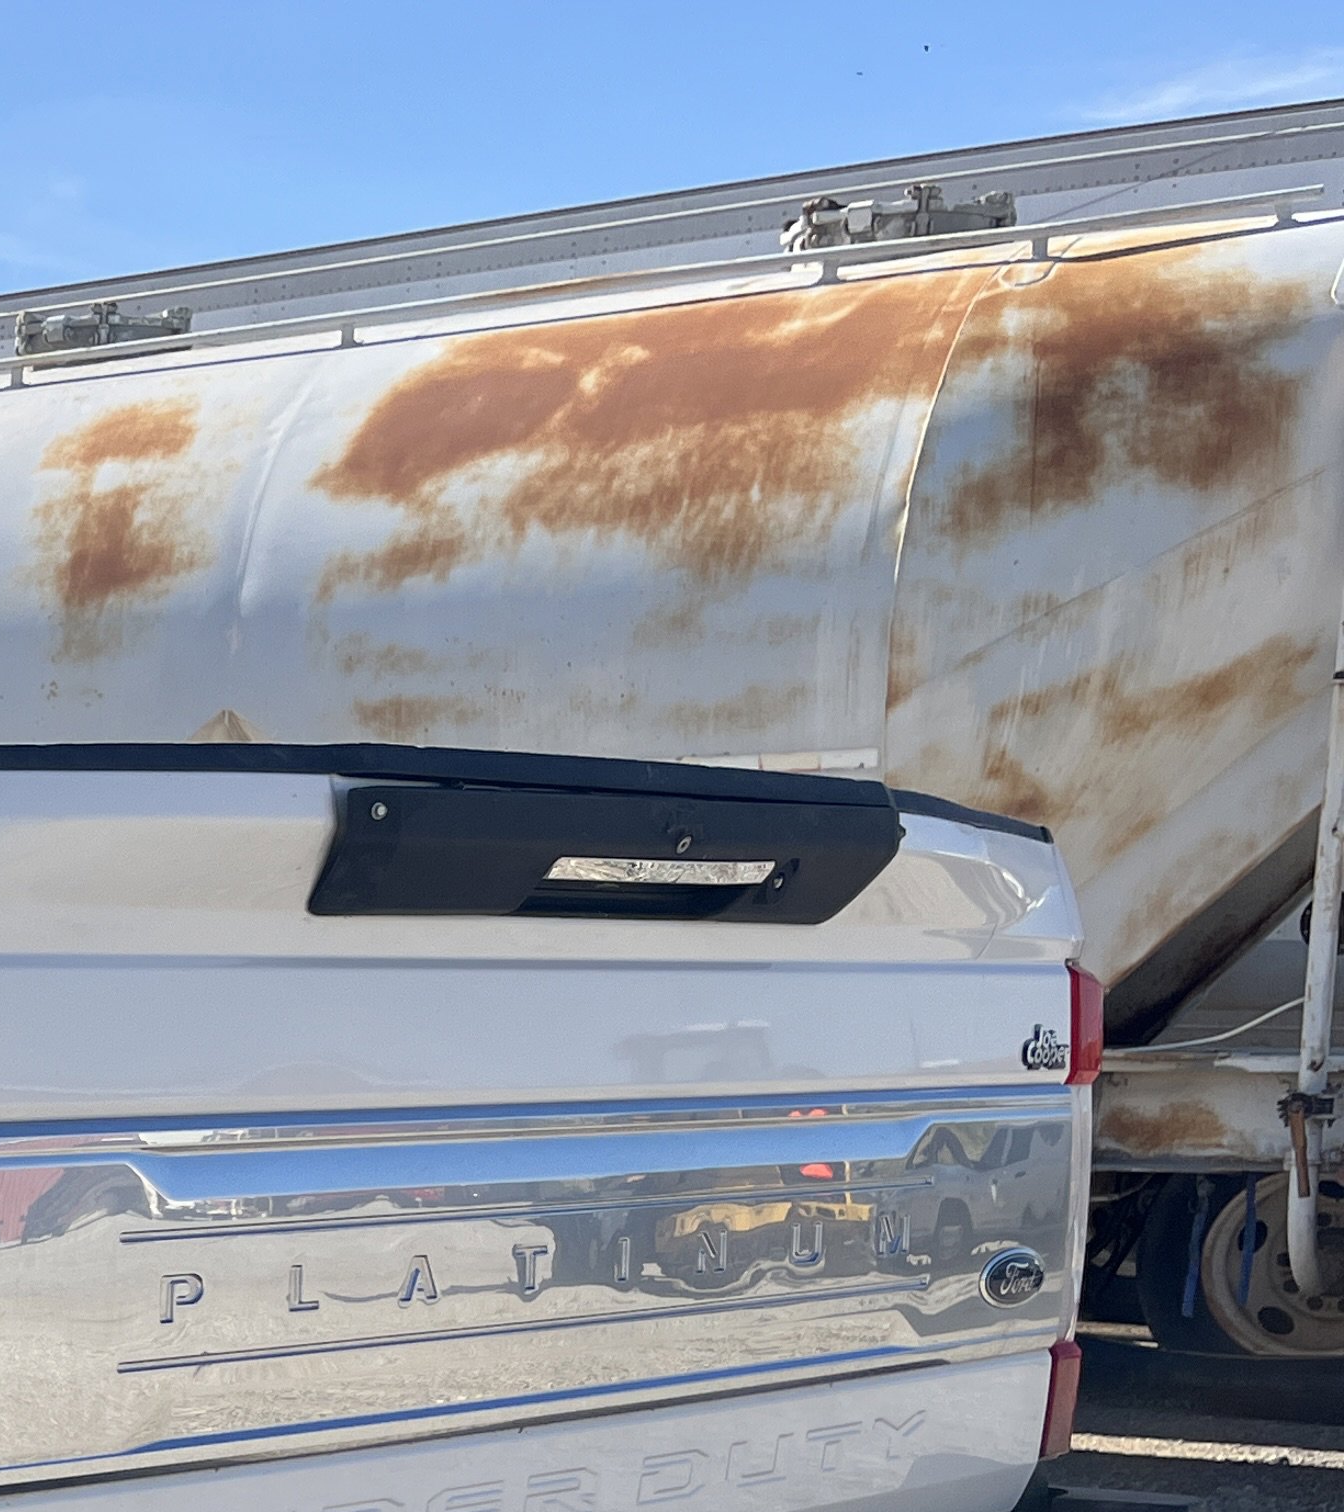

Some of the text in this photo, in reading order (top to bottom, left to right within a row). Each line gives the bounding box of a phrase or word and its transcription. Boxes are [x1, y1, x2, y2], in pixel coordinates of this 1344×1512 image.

[1025, 1040, 1070, 1067] Cooper
[1034, 1024, 1058, 1048] Joe
[159, 1207, 911, 1324] PLATINUM
[999, 1261, 1039, 1296] Ford
[636, 1410, 926, 1506] DUTY
